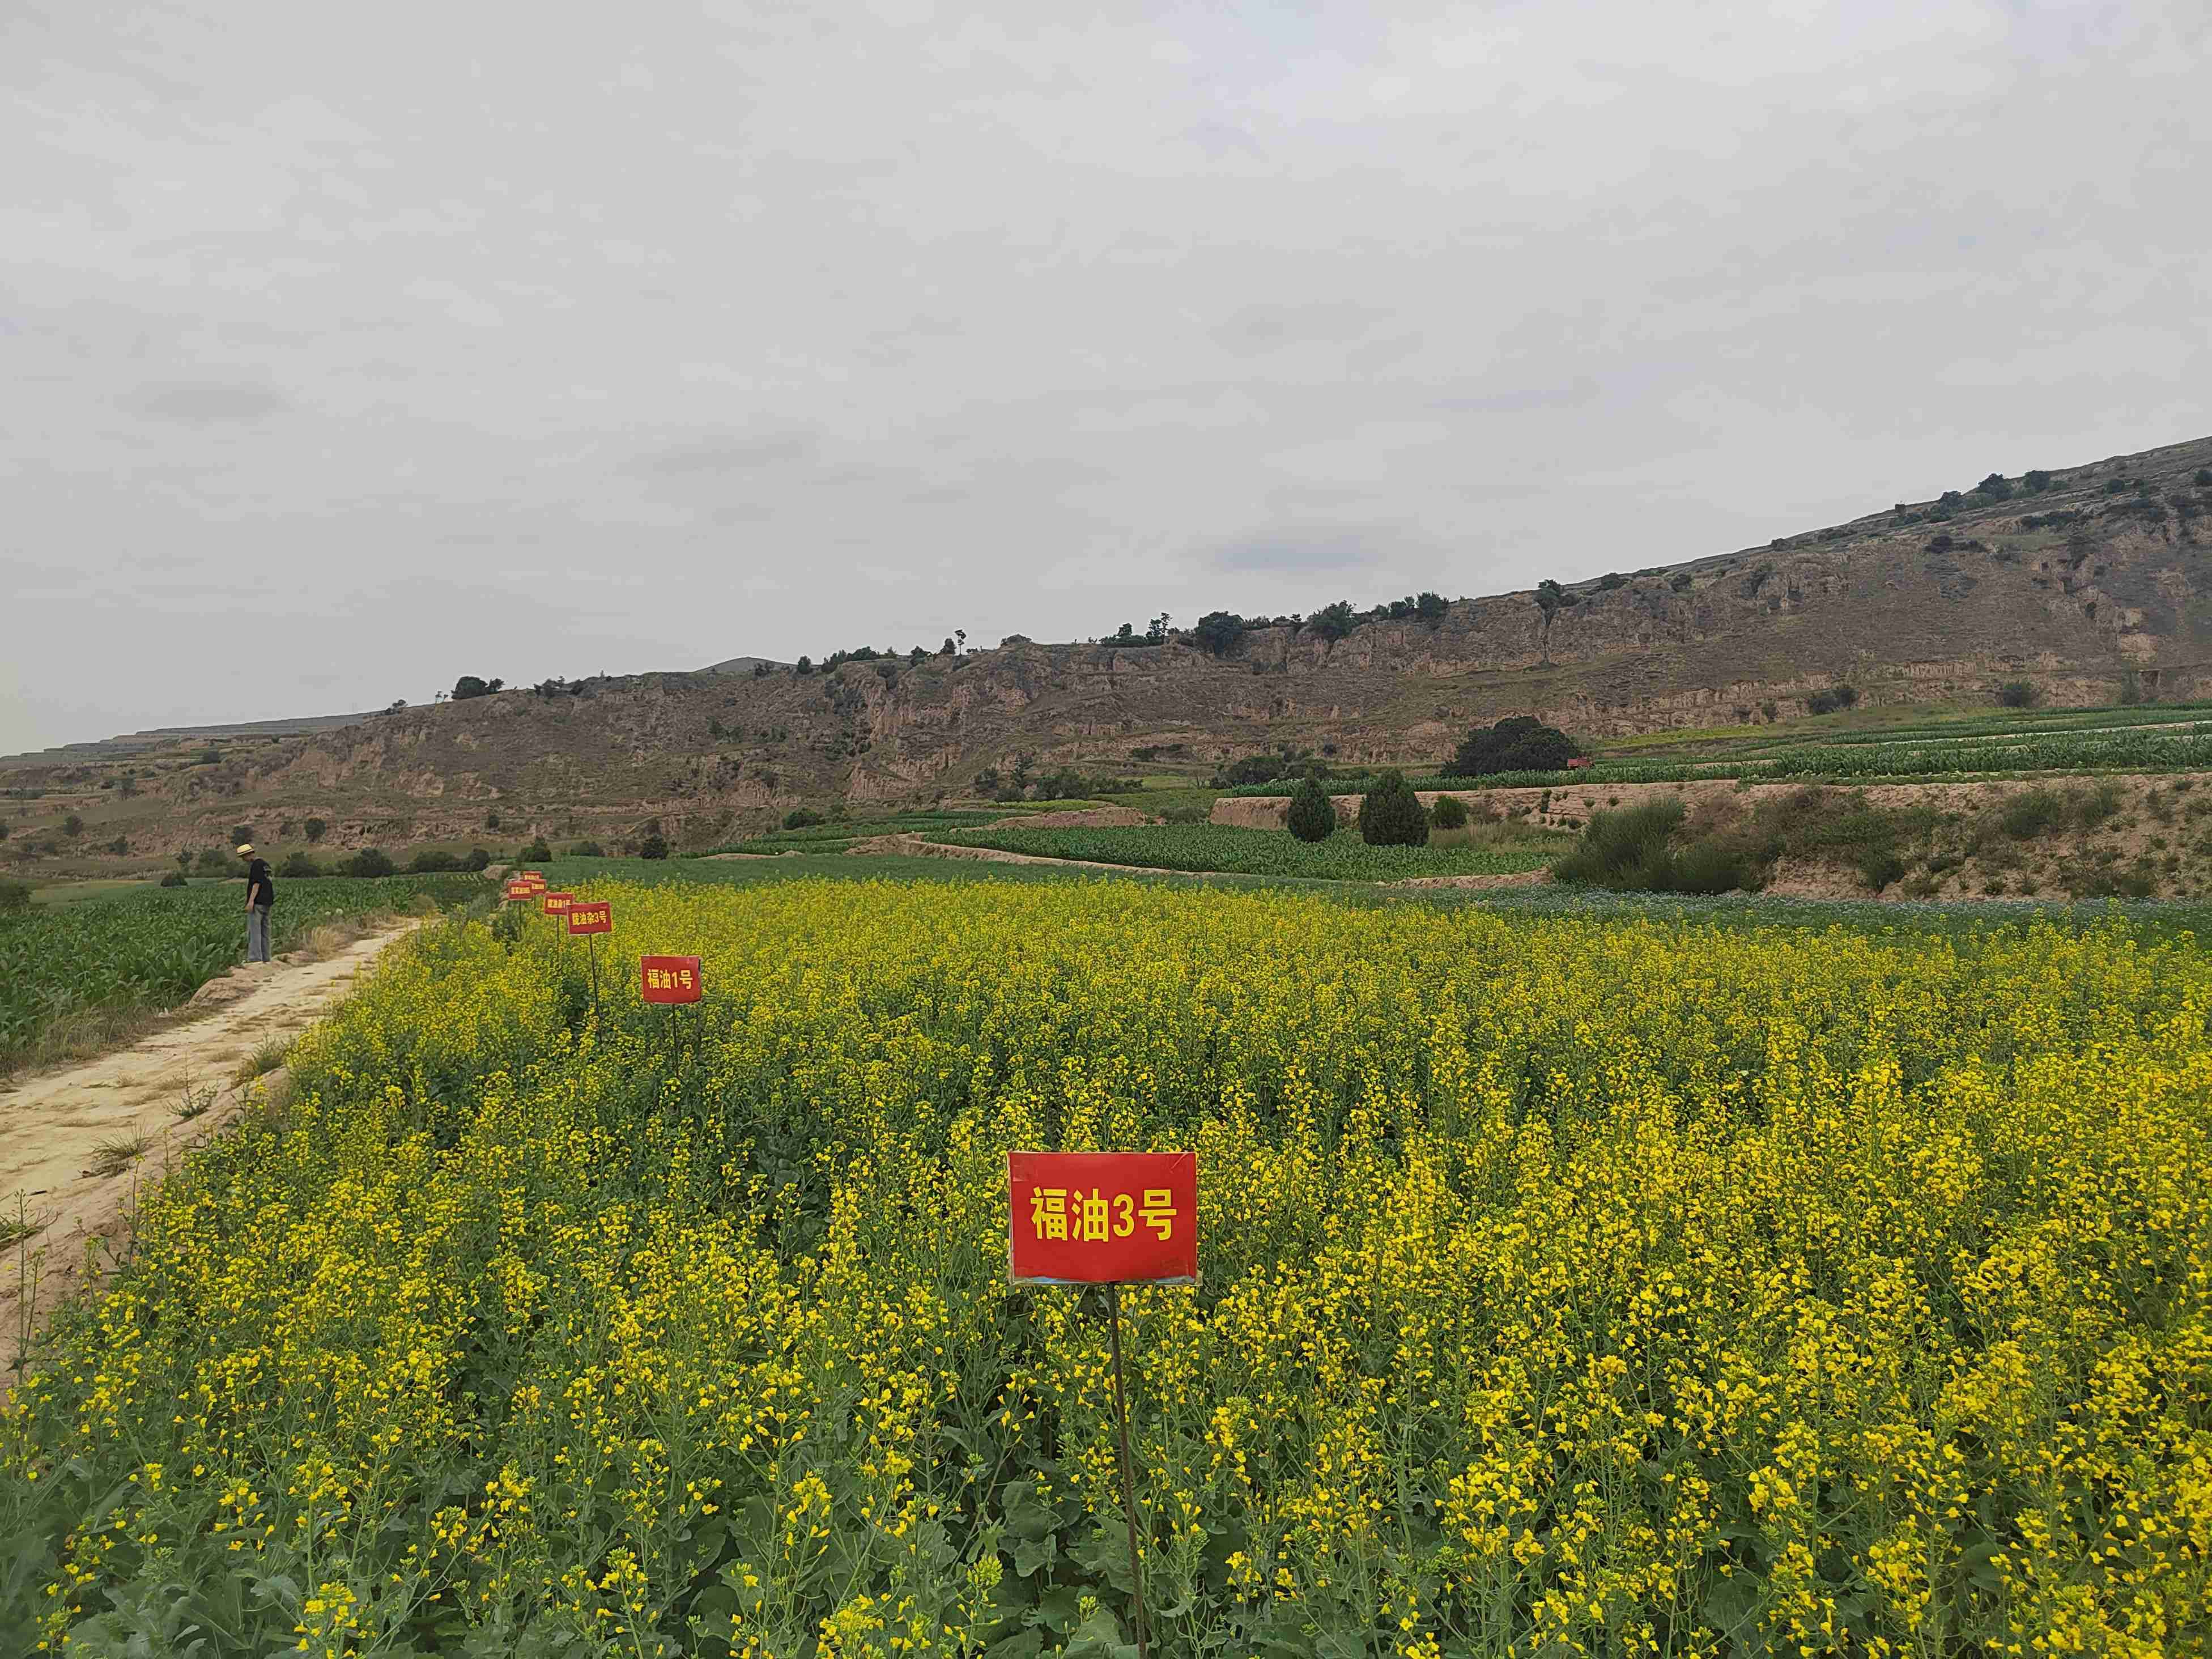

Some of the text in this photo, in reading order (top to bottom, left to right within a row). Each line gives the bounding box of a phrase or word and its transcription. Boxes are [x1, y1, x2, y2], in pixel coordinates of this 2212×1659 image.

[647, 968, 693, 989] 福油1号
[1030, 1186, 1177, 1242] 福油3号
